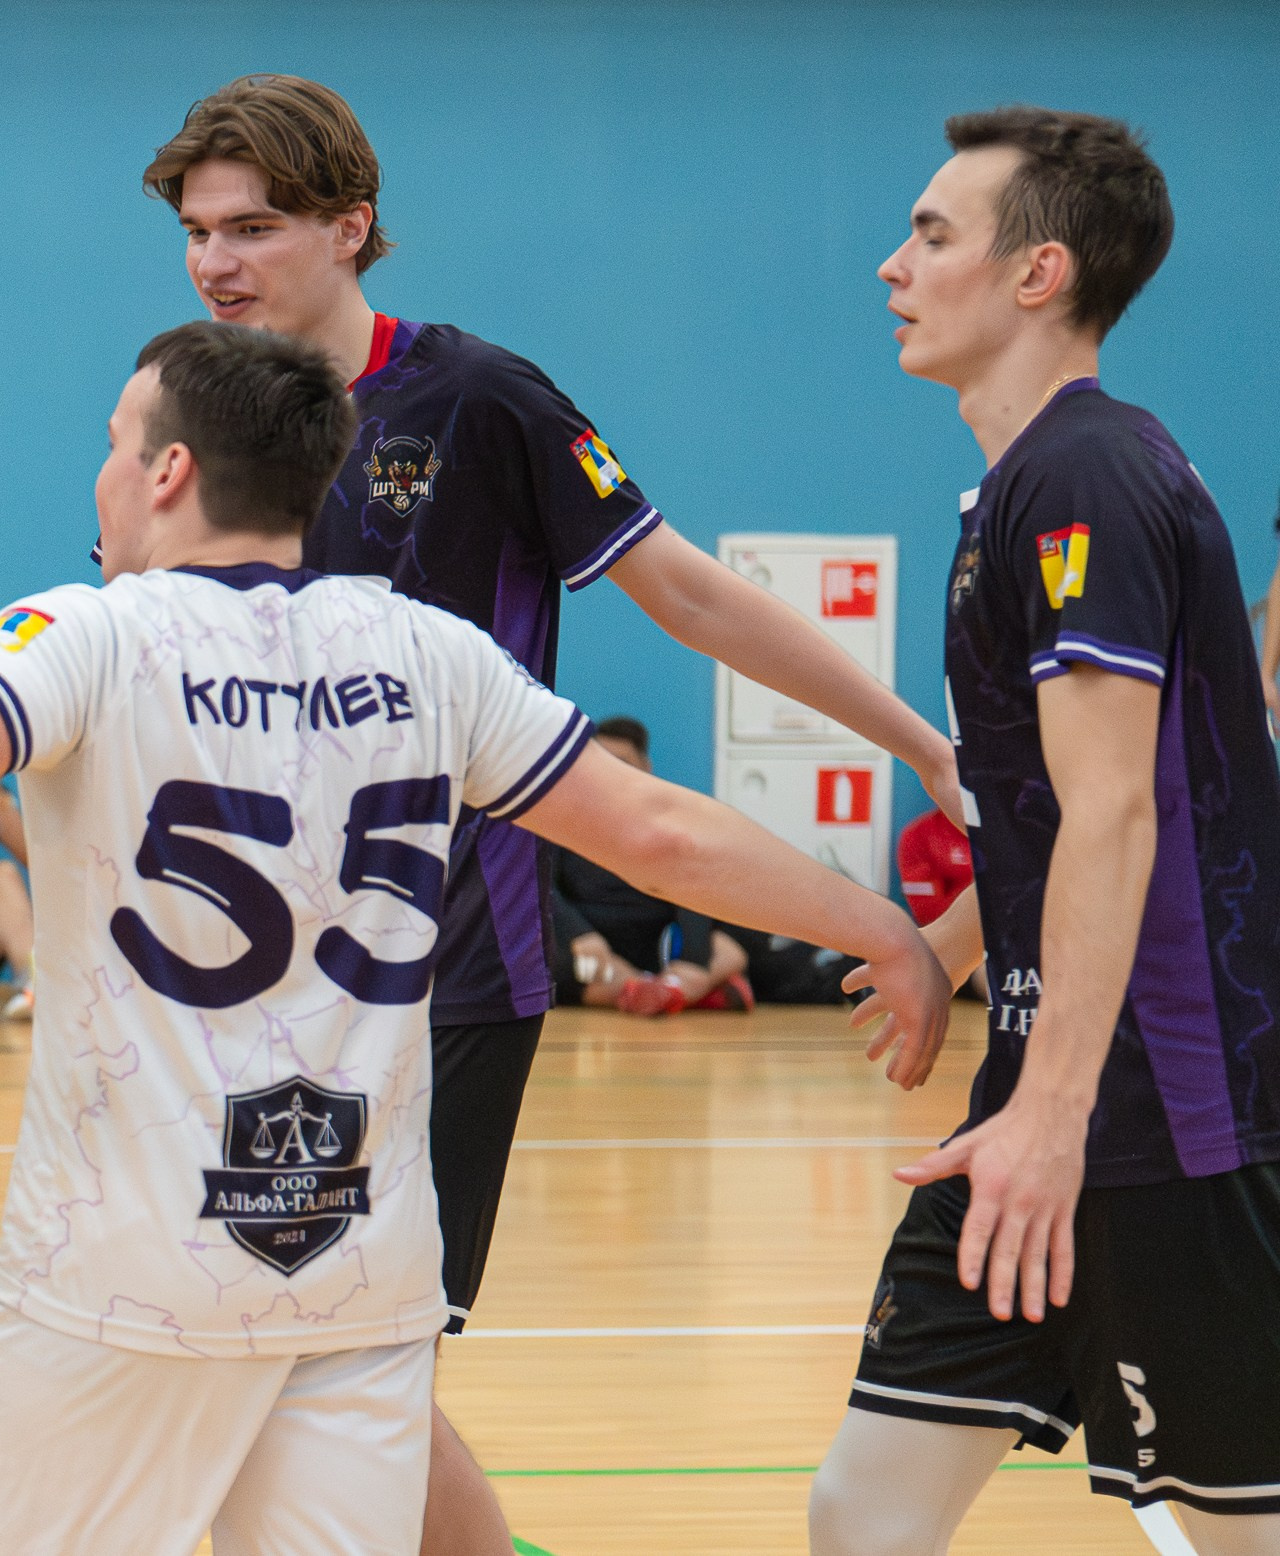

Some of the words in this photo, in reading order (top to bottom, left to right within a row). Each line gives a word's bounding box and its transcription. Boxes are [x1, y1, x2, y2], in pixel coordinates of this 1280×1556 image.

[373, 481, 429, 498] ШТРМ
[110, 774, 451, 1009] 55
[271, 1174, 317, 1192] ООО
